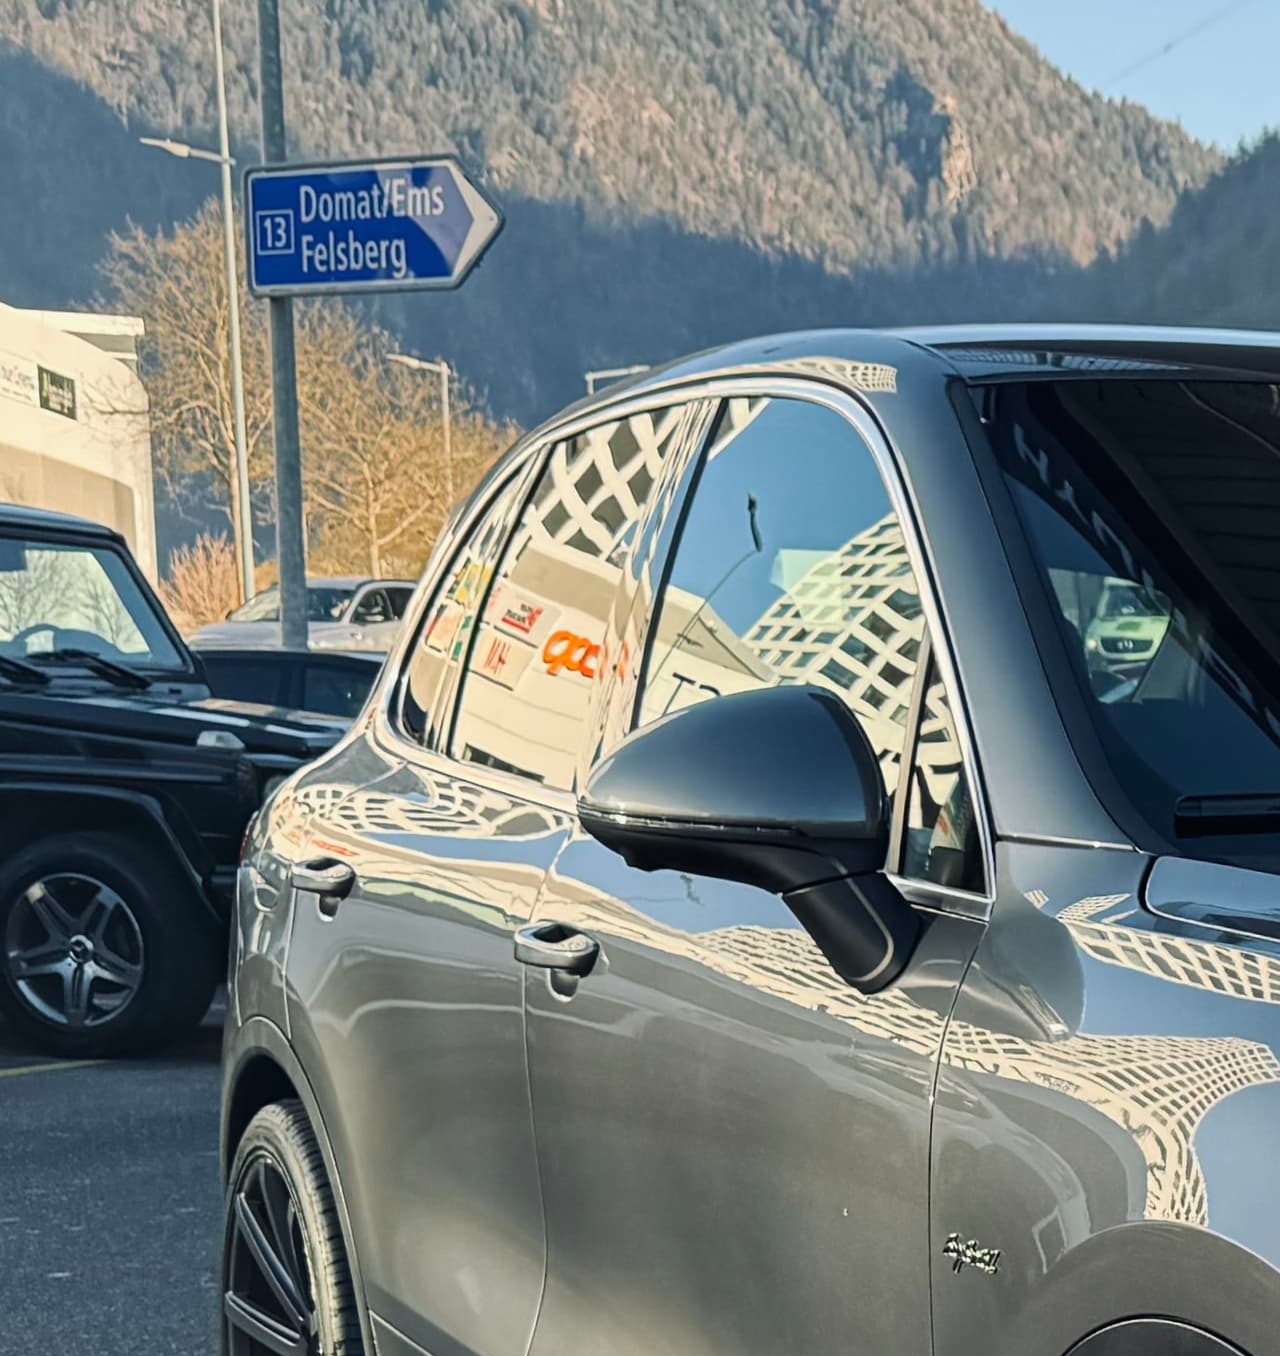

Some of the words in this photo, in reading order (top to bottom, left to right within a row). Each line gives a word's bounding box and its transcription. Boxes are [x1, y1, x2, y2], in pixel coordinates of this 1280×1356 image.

[301, 178, 444, 223] Domat/Ems
[262, 217, 287, 249] 13
[301, 231, 407, 279] Felsberg
